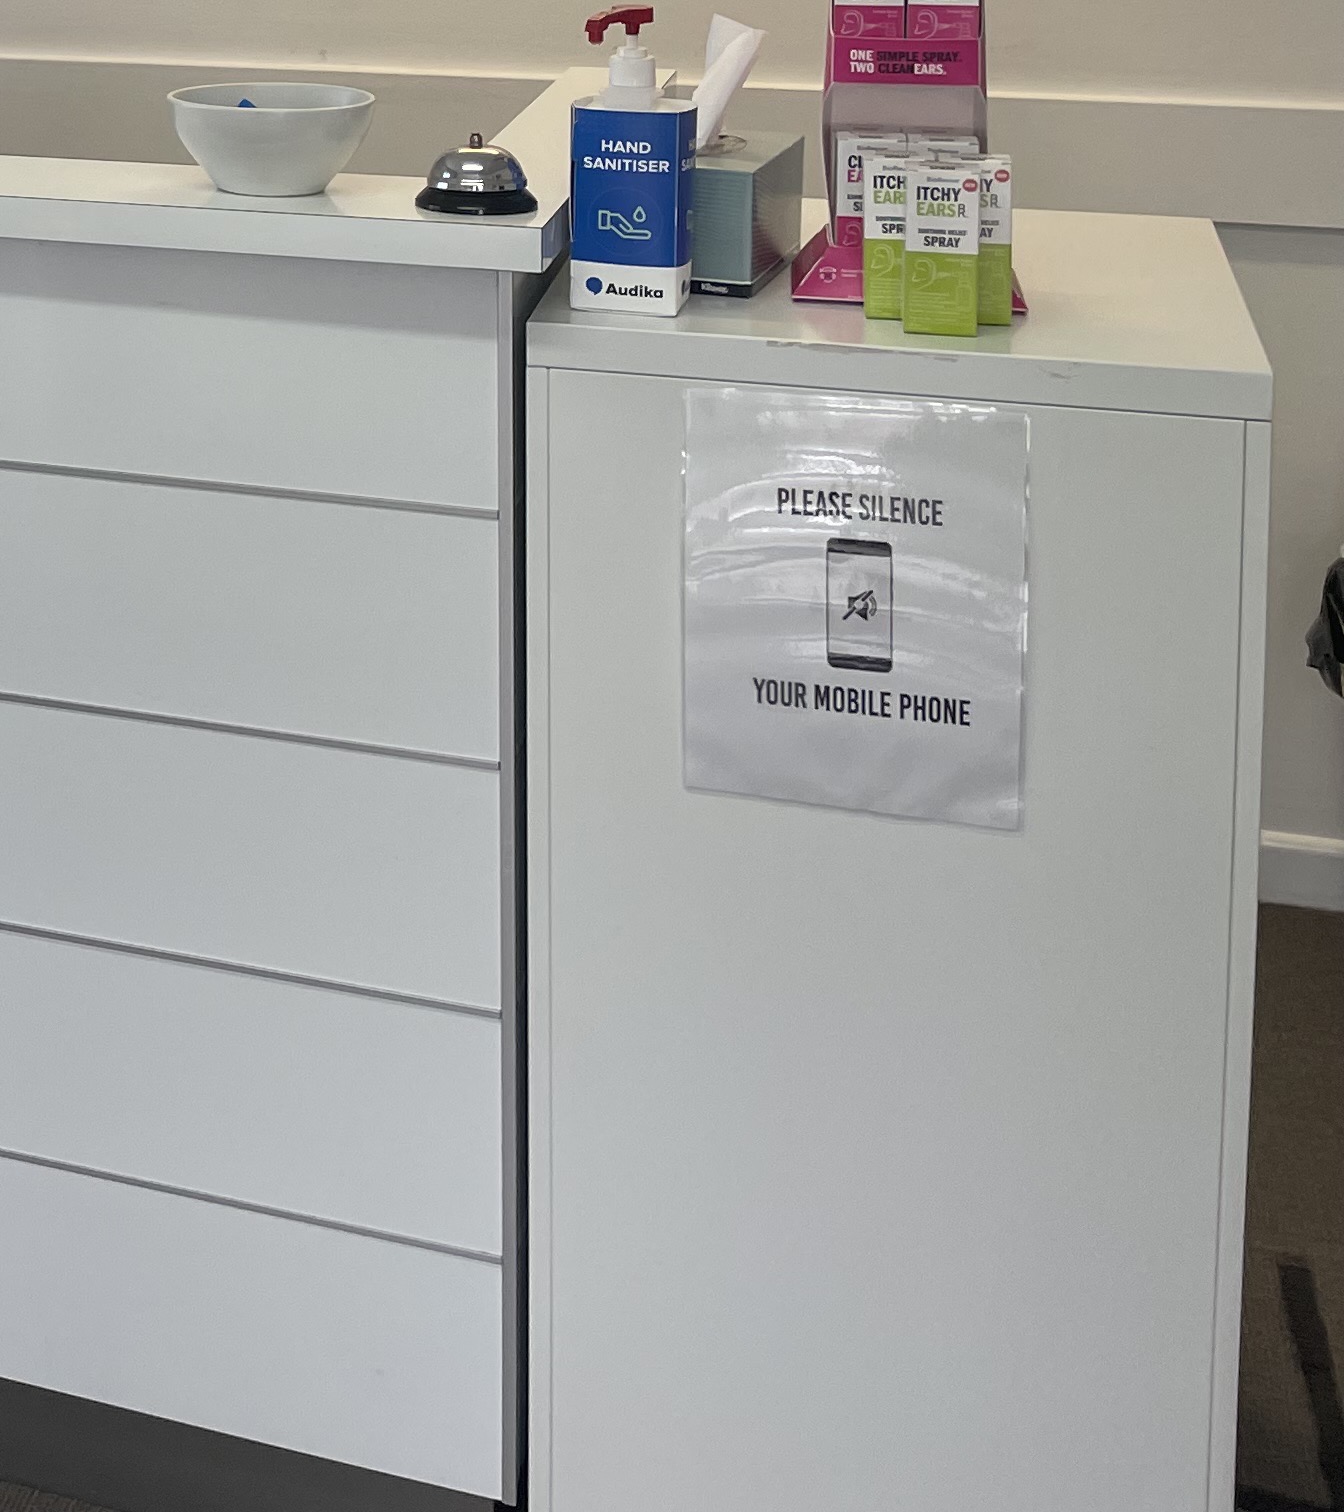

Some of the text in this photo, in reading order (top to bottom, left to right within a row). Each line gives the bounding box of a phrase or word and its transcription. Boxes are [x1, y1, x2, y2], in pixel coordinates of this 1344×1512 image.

[849, 49, 874, 61] ONE
[876, 50, 920, 62] SIMPLE
[849, 61, 875, 74] TWO
[601, 139, 652, 155] HAND
[583, 156, 670, 173] SANITISER
[872, 175, 906, 190] ITCH
[873, 190, 906, 204] EAR
[916, 186, 962, 202] ITCHY
[923, 235, 961, 248] SPRAY
[605, 283, 664, 299] Audika
[777, 487, 944, 527] PLEASE SILENCE
[752, 677, 971, 727] YOUR MOBILE PHONE
